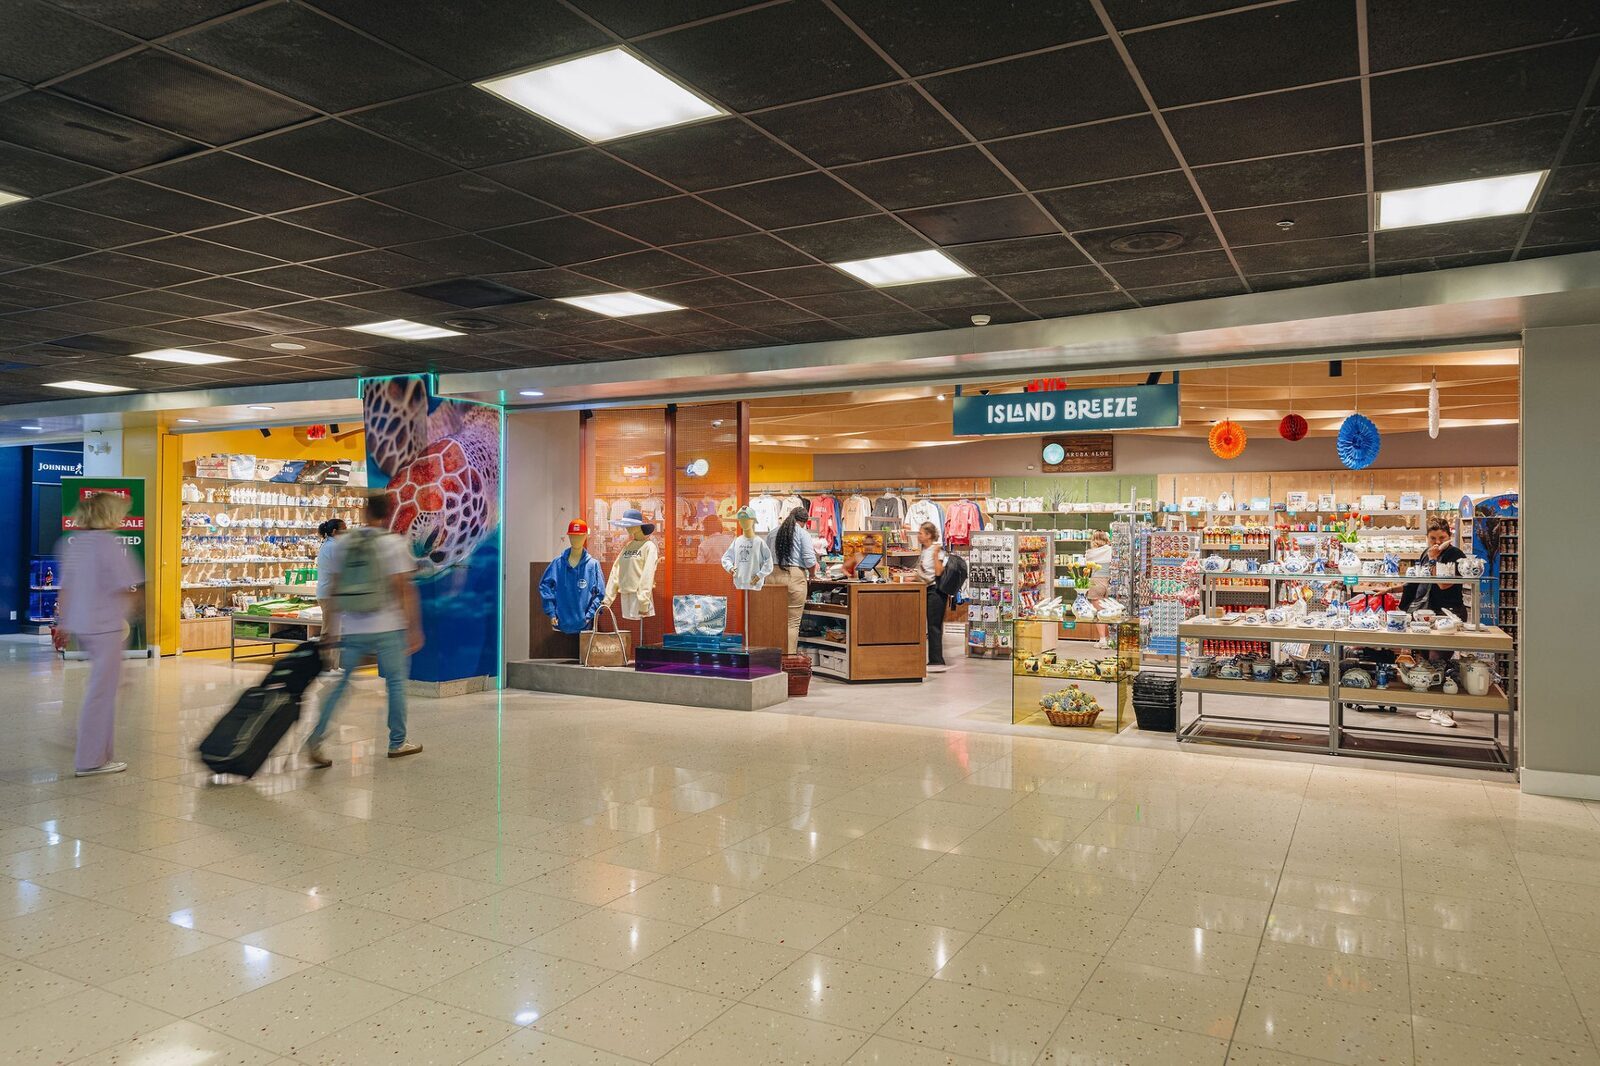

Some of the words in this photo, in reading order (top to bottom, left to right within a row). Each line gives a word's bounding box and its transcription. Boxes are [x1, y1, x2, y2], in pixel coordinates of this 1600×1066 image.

[987, 402, 1056, 424] ISLAND
[1064, 397, 1138, 420] BREEZE
[38, 462, 75, 472] JOHNNIE
[119, 519, 144, 528] SALE
